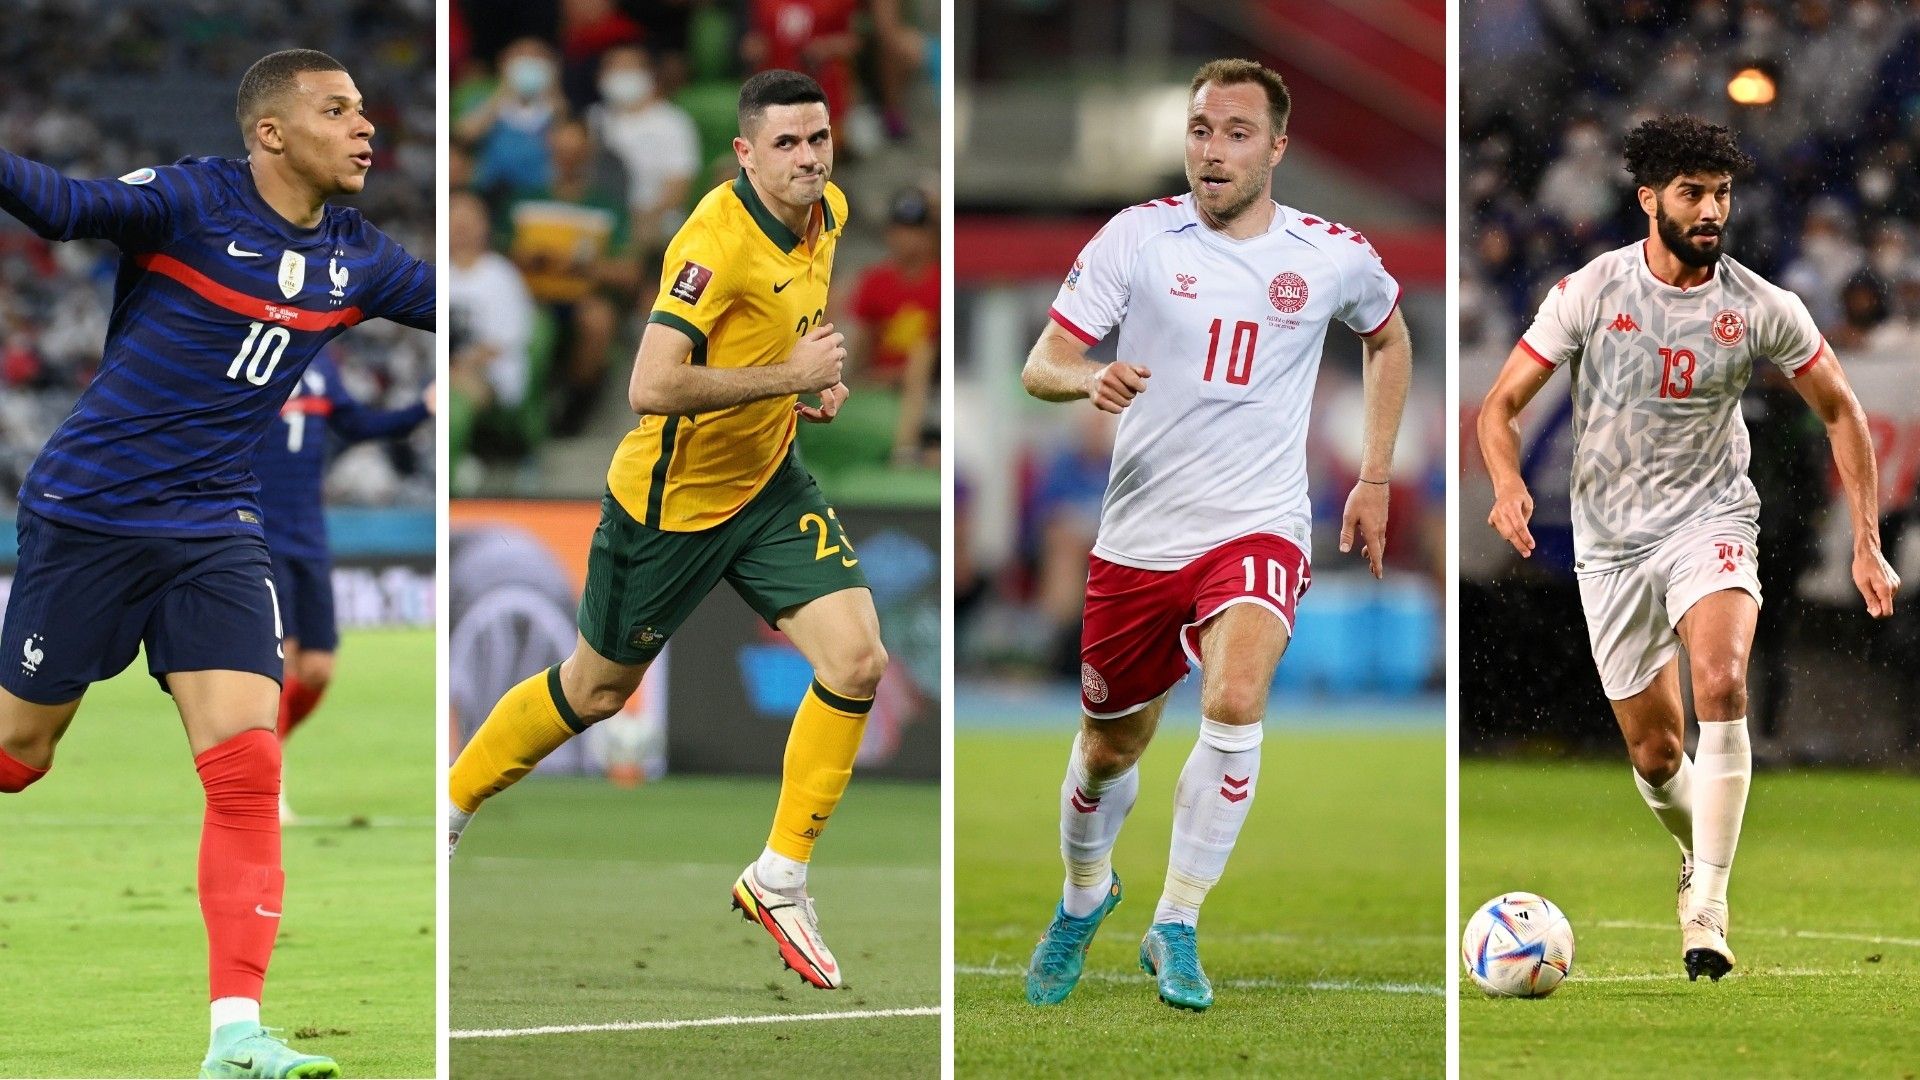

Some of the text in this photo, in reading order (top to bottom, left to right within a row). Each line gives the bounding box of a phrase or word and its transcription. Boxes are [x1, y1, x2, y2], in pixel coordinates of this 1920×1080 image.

[1170, 288, 1197, 299] hummel
[1277, 285, 1301, 299] DBU
[227, 321, 290, 386] 10
[1203, 318, 1259, 385] 10
[1658, 348, 1696, 399] 13
[283, 411, 305, 453] 1
[1242, 555, 1287, 607] 10
[264, 578, 284, 658] 1
